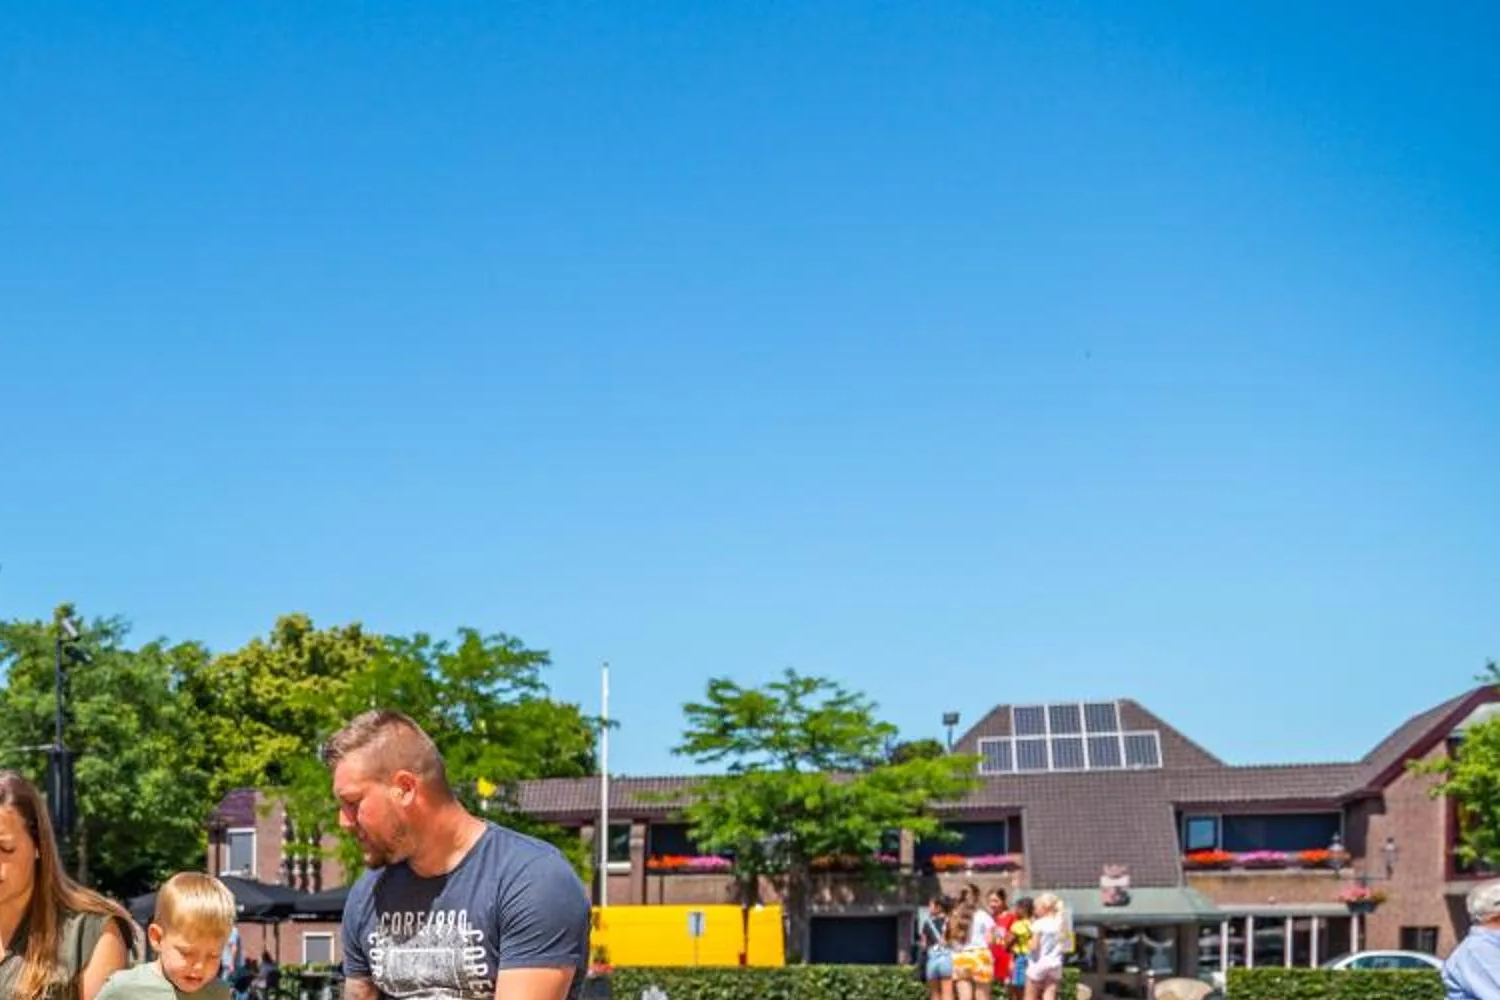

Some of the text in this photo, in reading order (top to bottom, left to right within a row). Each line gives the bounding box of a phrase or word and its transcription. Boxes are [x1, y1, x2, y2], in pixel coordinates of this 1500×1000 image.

[381, 911, 426, 936] CORE
[368, 931, 385, 984] COR
[463, 929, 493, 990] CORE
